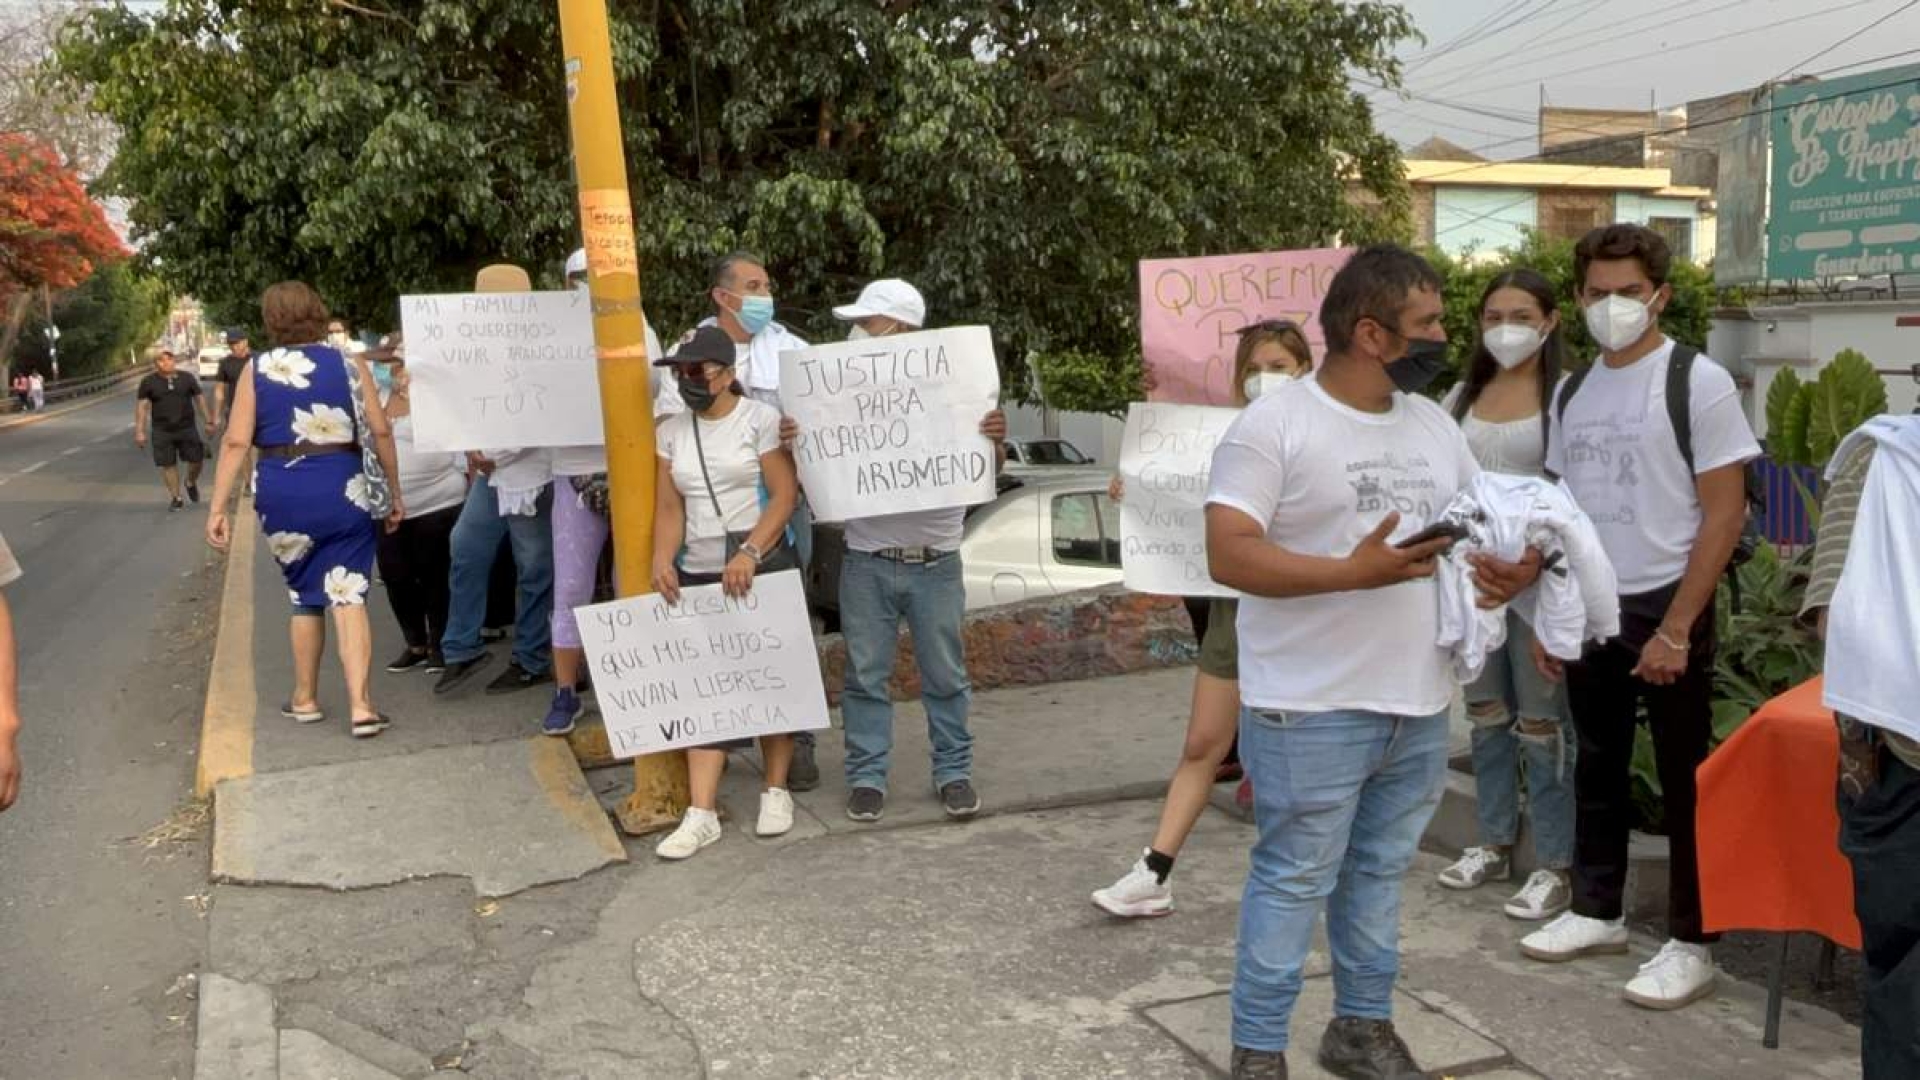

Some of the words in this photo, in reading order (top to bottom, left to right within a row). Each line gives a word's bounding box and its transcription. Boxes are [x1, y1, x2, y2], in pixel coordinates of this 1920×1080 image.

[415, 298, 440, 316] MI
[462, 297, 538, 315] FAMILIA
[457, 321, 556, 341] QUEREMOS
[441, 345, 490, 365] VIVIR
[797, 345, 950, 398] JUSTICIA
[854, 387, 924, 421] PARA
[795, 419, 909, 463] RICARDO
[601, 648, 648, 679] QUE
[653, 637, 700, 665] MIS
[708, 627, 783, 660] HIJOS
[608, 680, 679, 711] VIVAN
[694, 666, 787, 699] LIBRES
[615, 725, 648, 750] DE
[659, 703, 790, 742] VIOLENCIA
